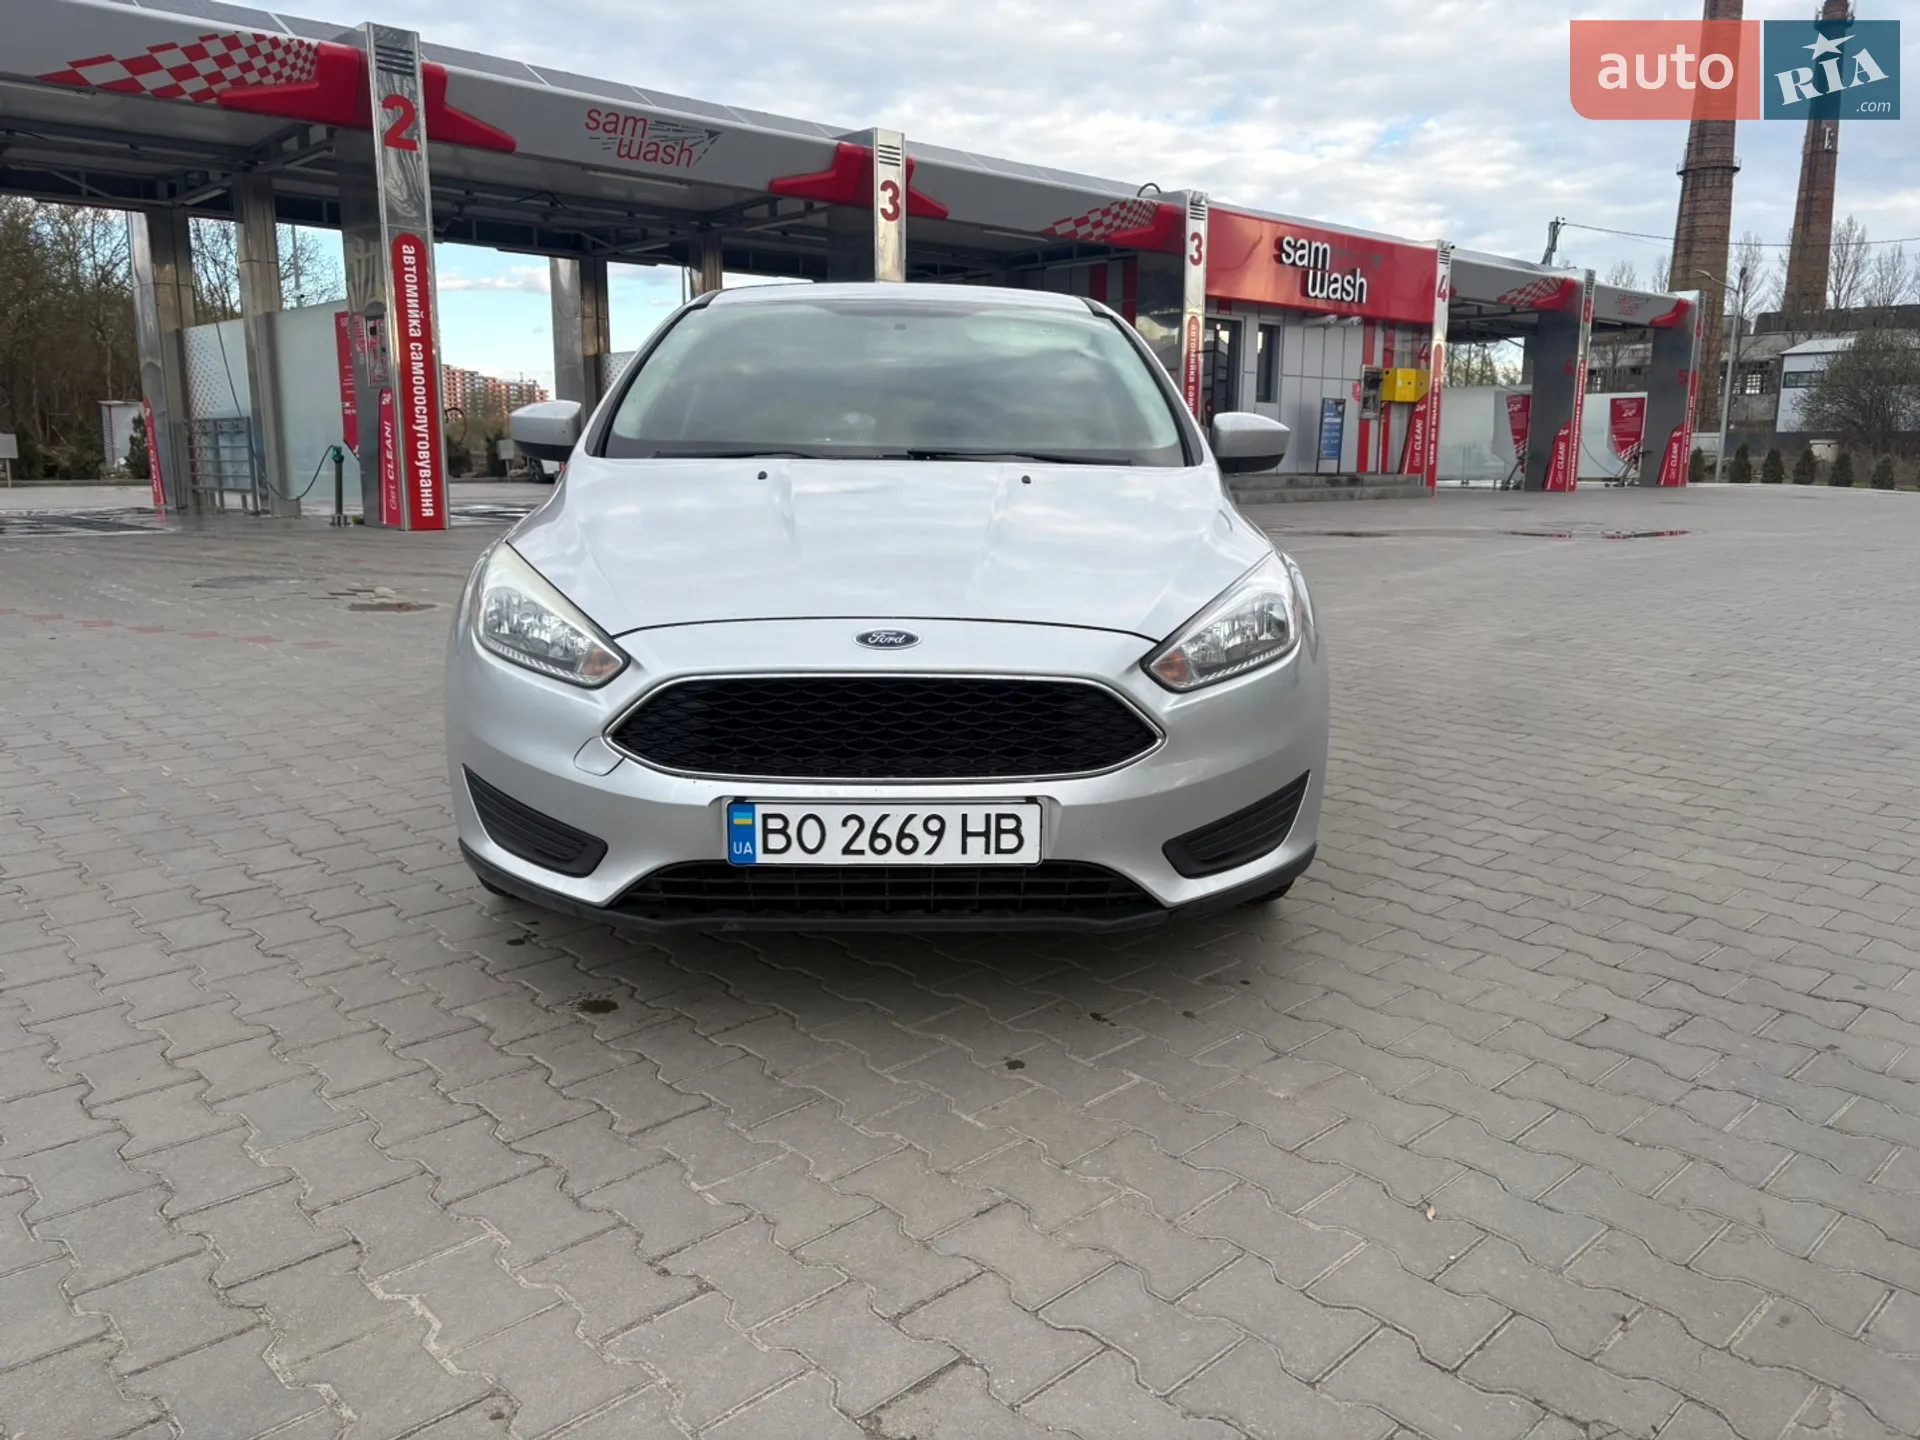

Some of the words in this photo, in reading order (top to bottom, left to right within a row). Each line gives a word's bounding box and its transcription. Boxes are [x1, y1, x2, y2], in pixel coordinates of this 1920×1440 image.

[381, 94, 418, 152] 2
[585, 108, 648, 139] sam
[616, 137, 693, 168] wash
[880, 179, 900, 222] 3
[1189, 232, 1203, 266] 3
[1281, 235, 1331, 271] sam
[402, 244, 425, 338] автомийка
[1307, 267, 1367, 304] wash
[1437, 274, 1448, 302] 4
[1188, 324, 1197, 382] автомийка
[1418, 343, 1430, 362] 4
[868, 632, 906, 644] Ford
[733, 841, 753, 855] UA
[761, 812, 827, 855] BO
[841, 812, 947, 856] 2669
[961, 812, 1024, 855] HB
